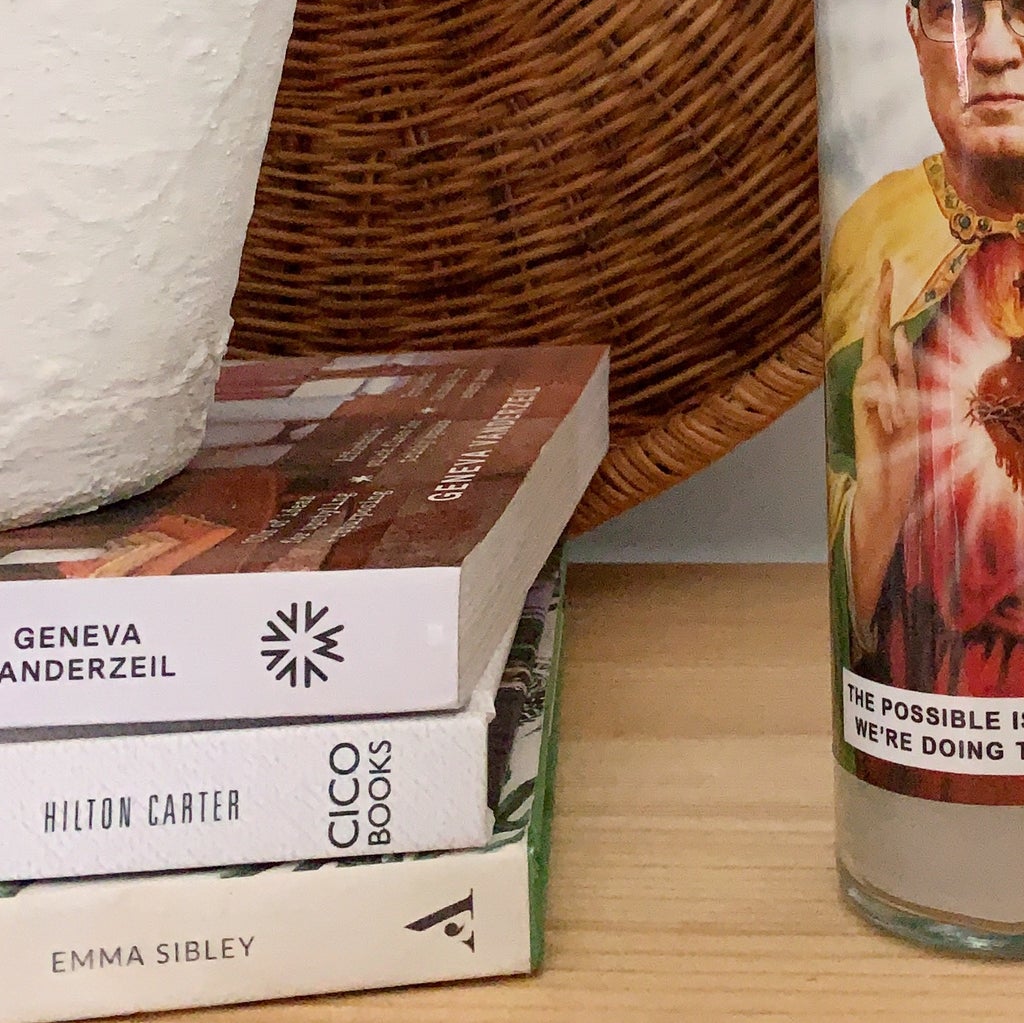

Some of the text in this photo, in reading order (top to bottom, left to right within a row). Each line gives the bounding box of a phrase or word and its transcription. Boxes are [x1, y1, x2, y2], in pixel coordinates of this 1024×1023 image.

[427, 449, 493, 502] GENEVA
[14, 623, 141, 649] GENEVA
[847, 683, 875, 712] THE
[881, 697, 1001, 730] POSSIBLE
[855, 716, 912, 752] WE'RE
[922, 735, 1004, 760] DOING
[44, 789, 239, 833] HILTON CARTER
[328, 742, 360, 849] CICO
[367, 740, 392, 846] BOOKS
[51, 935, 255, 974] EMMA SIBLEY
